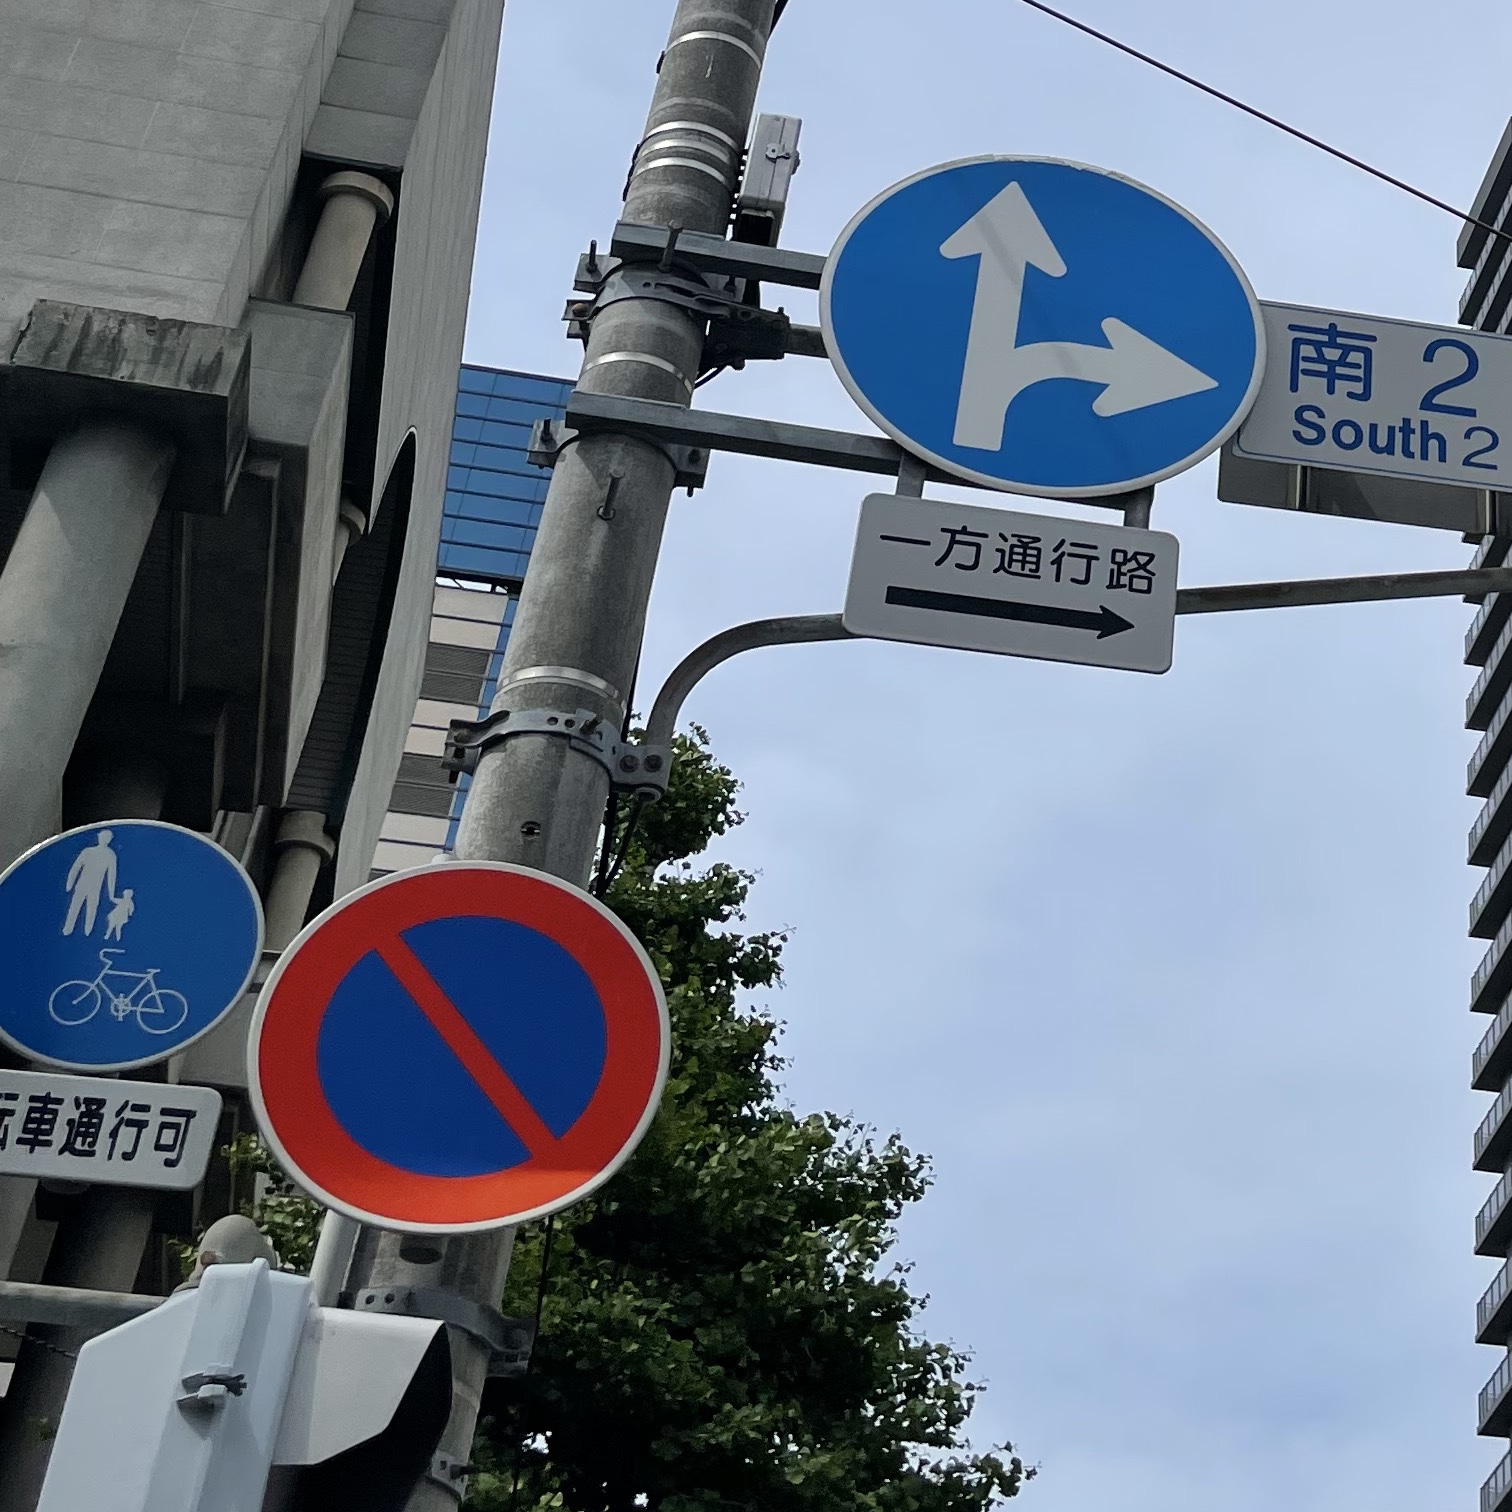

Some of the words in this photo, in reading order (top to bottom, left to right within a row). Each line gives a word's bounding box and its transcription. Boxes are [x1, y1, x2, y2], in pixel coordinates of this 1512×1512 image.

[879, 524, 1158, 595] 一方通行路
